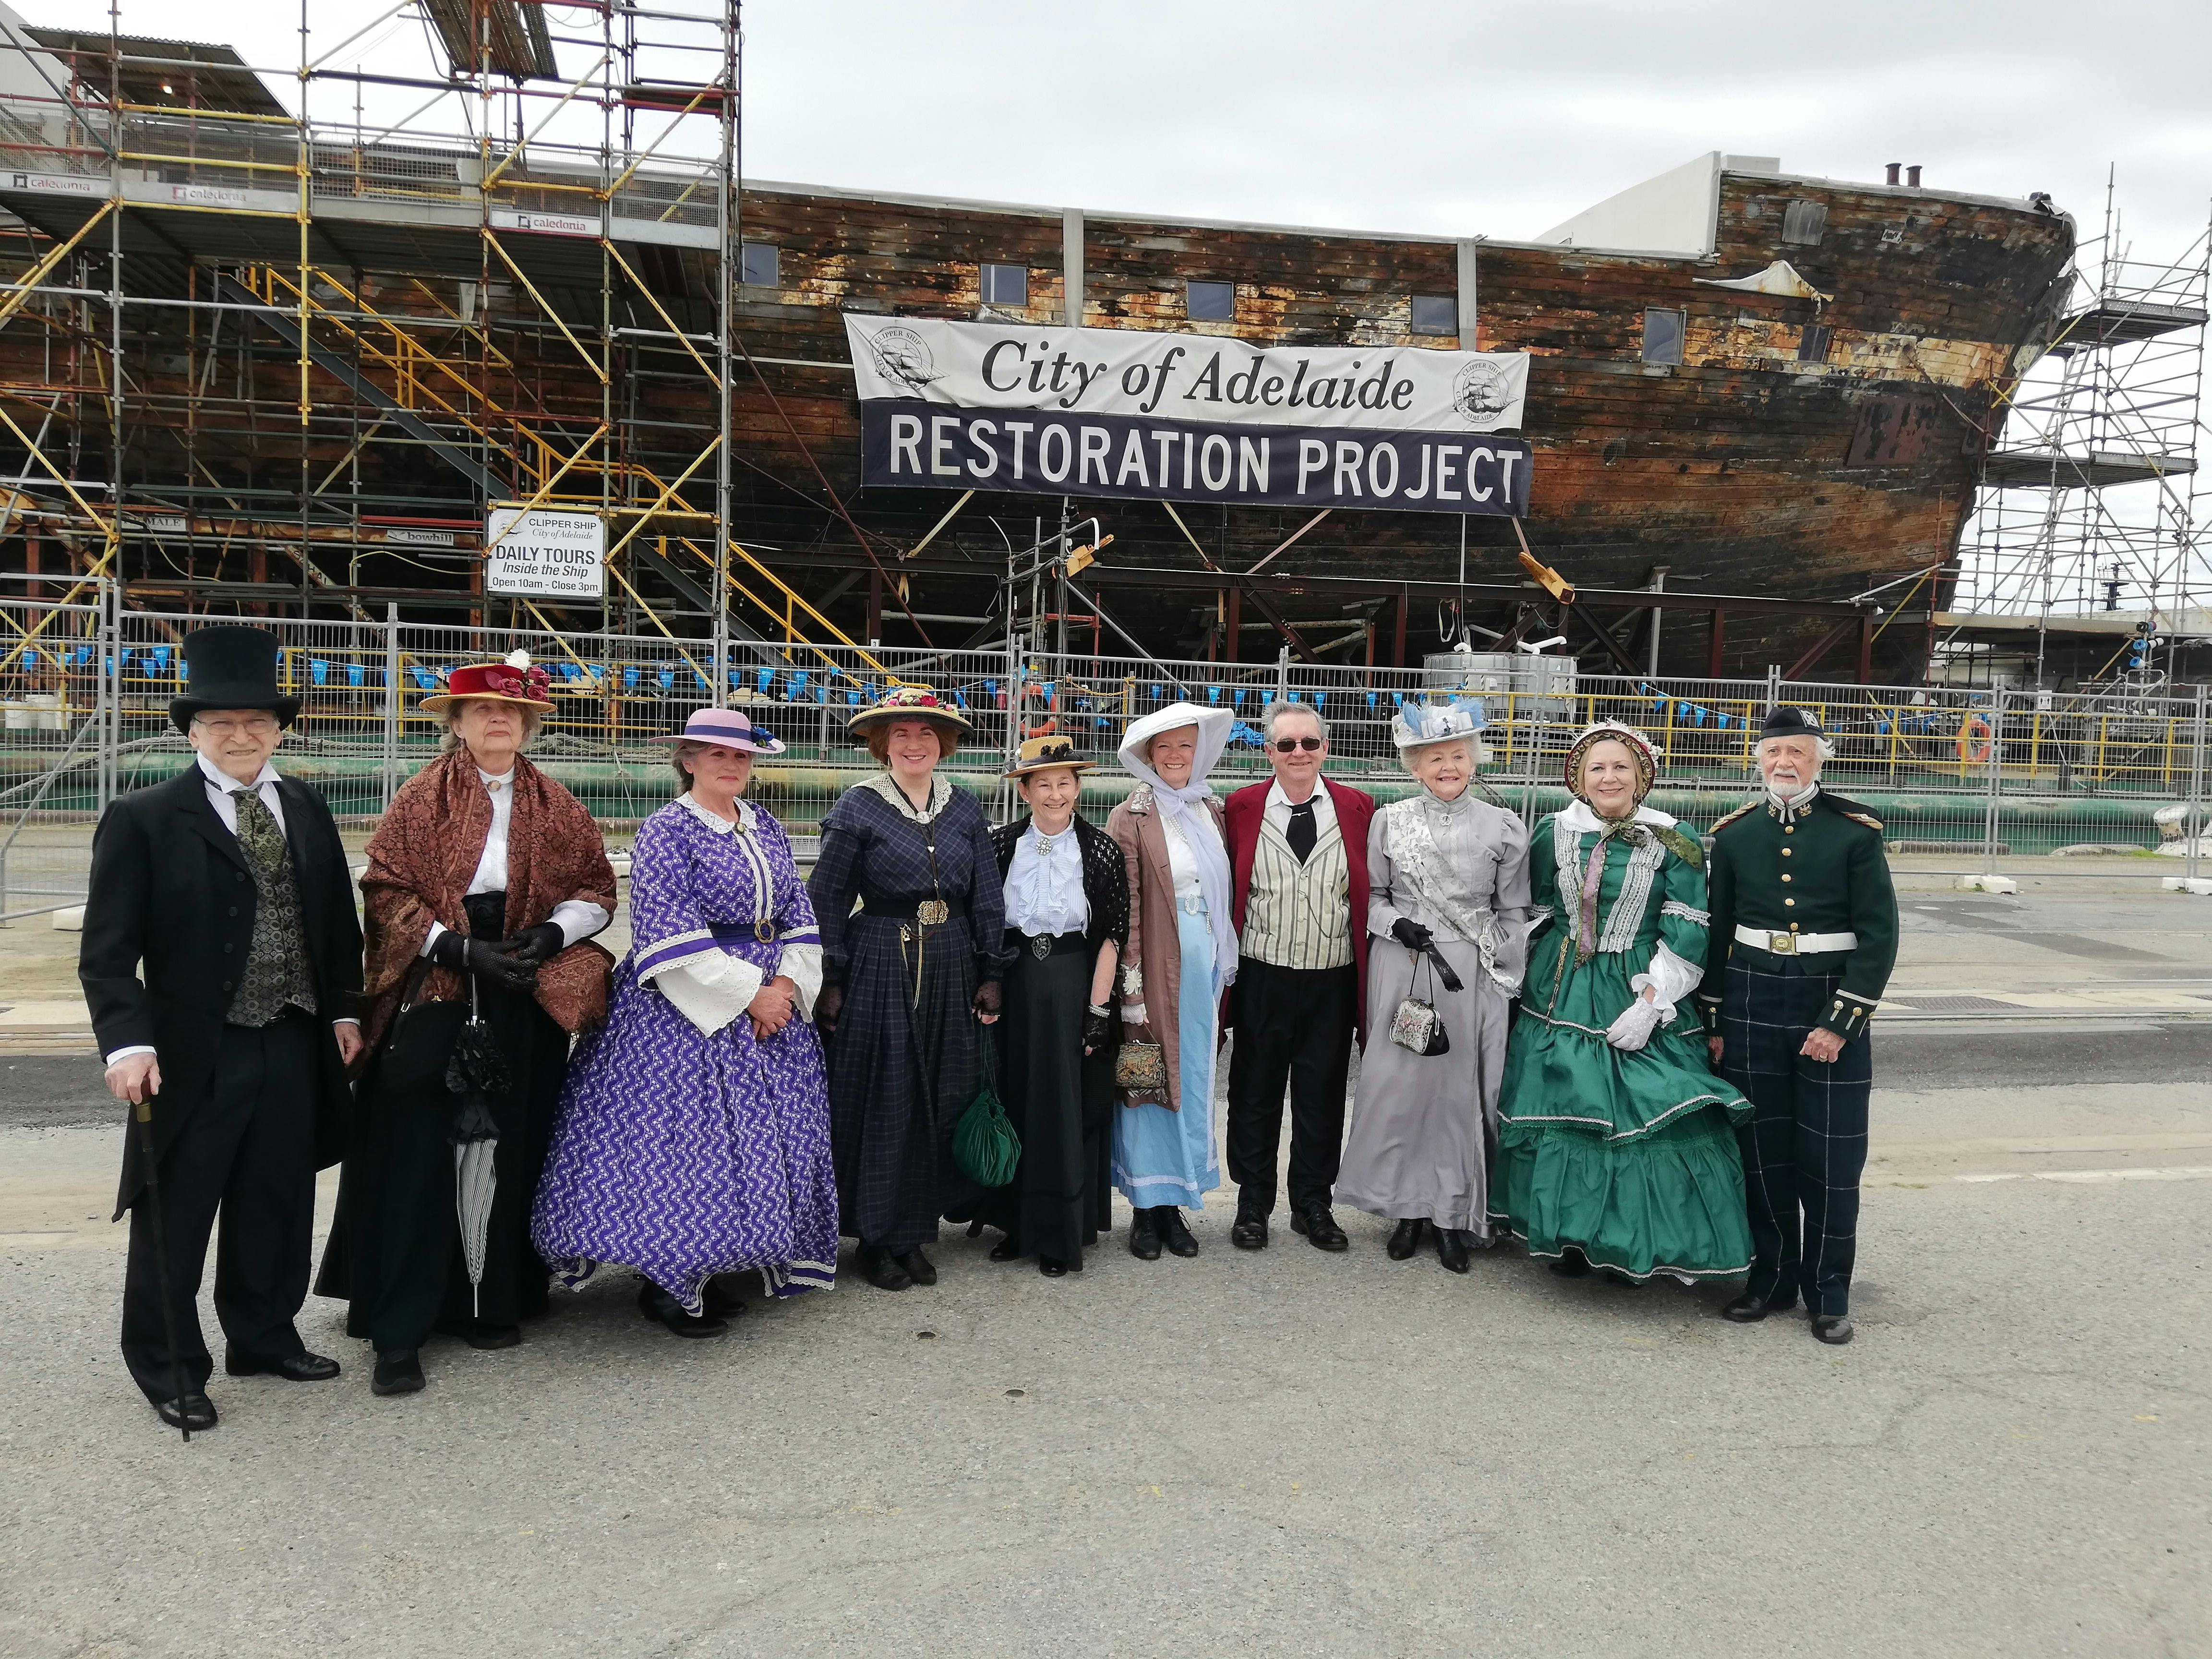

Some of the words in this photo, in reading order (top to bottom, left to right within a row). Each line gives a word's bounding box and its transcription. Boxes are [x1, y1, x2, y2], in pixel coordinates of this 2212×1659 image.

[190, 189, 246, 201] caledoia
[534, 218, 586, 231] caledonia
[875, 330, 903, 344] CLIPPER
[905, 332, 922, 346] SHIP
[876, 355, 887, 371] CITY
[1463, 363, 1486, 376] CLIPPER
[982, 340, 1107, 408] City
[1121, 347, 1186, 413] of
[1183, 351, 1414, 410] Adelaide
[890, 414, 1270, 493] RESTORATION
[1297, 439, 1522, 503] PROJECT
[529, 518, 571, 529] CLIPPER
[574, 521, 596, 529] SHIP
[408, 531, 452, 542] bowhill
[532, 529, 551, 539] City
[551, 530, 559, 539] of
[559, 530, 593, 539] Adelaide
[496, 545, 539, 561] DAILY
[543, 548, 595, 565] TOURS
[503, 562, 538, 574] Inside
[541, 564, 559, 576] the
[563, 565, 588, 579] Ship
[493, 577, 515, 588] Open
[518, 579, 542, 588] 10am
[552, 580, 576, 590] Close
[578, 582, 598, 592] 3pm
